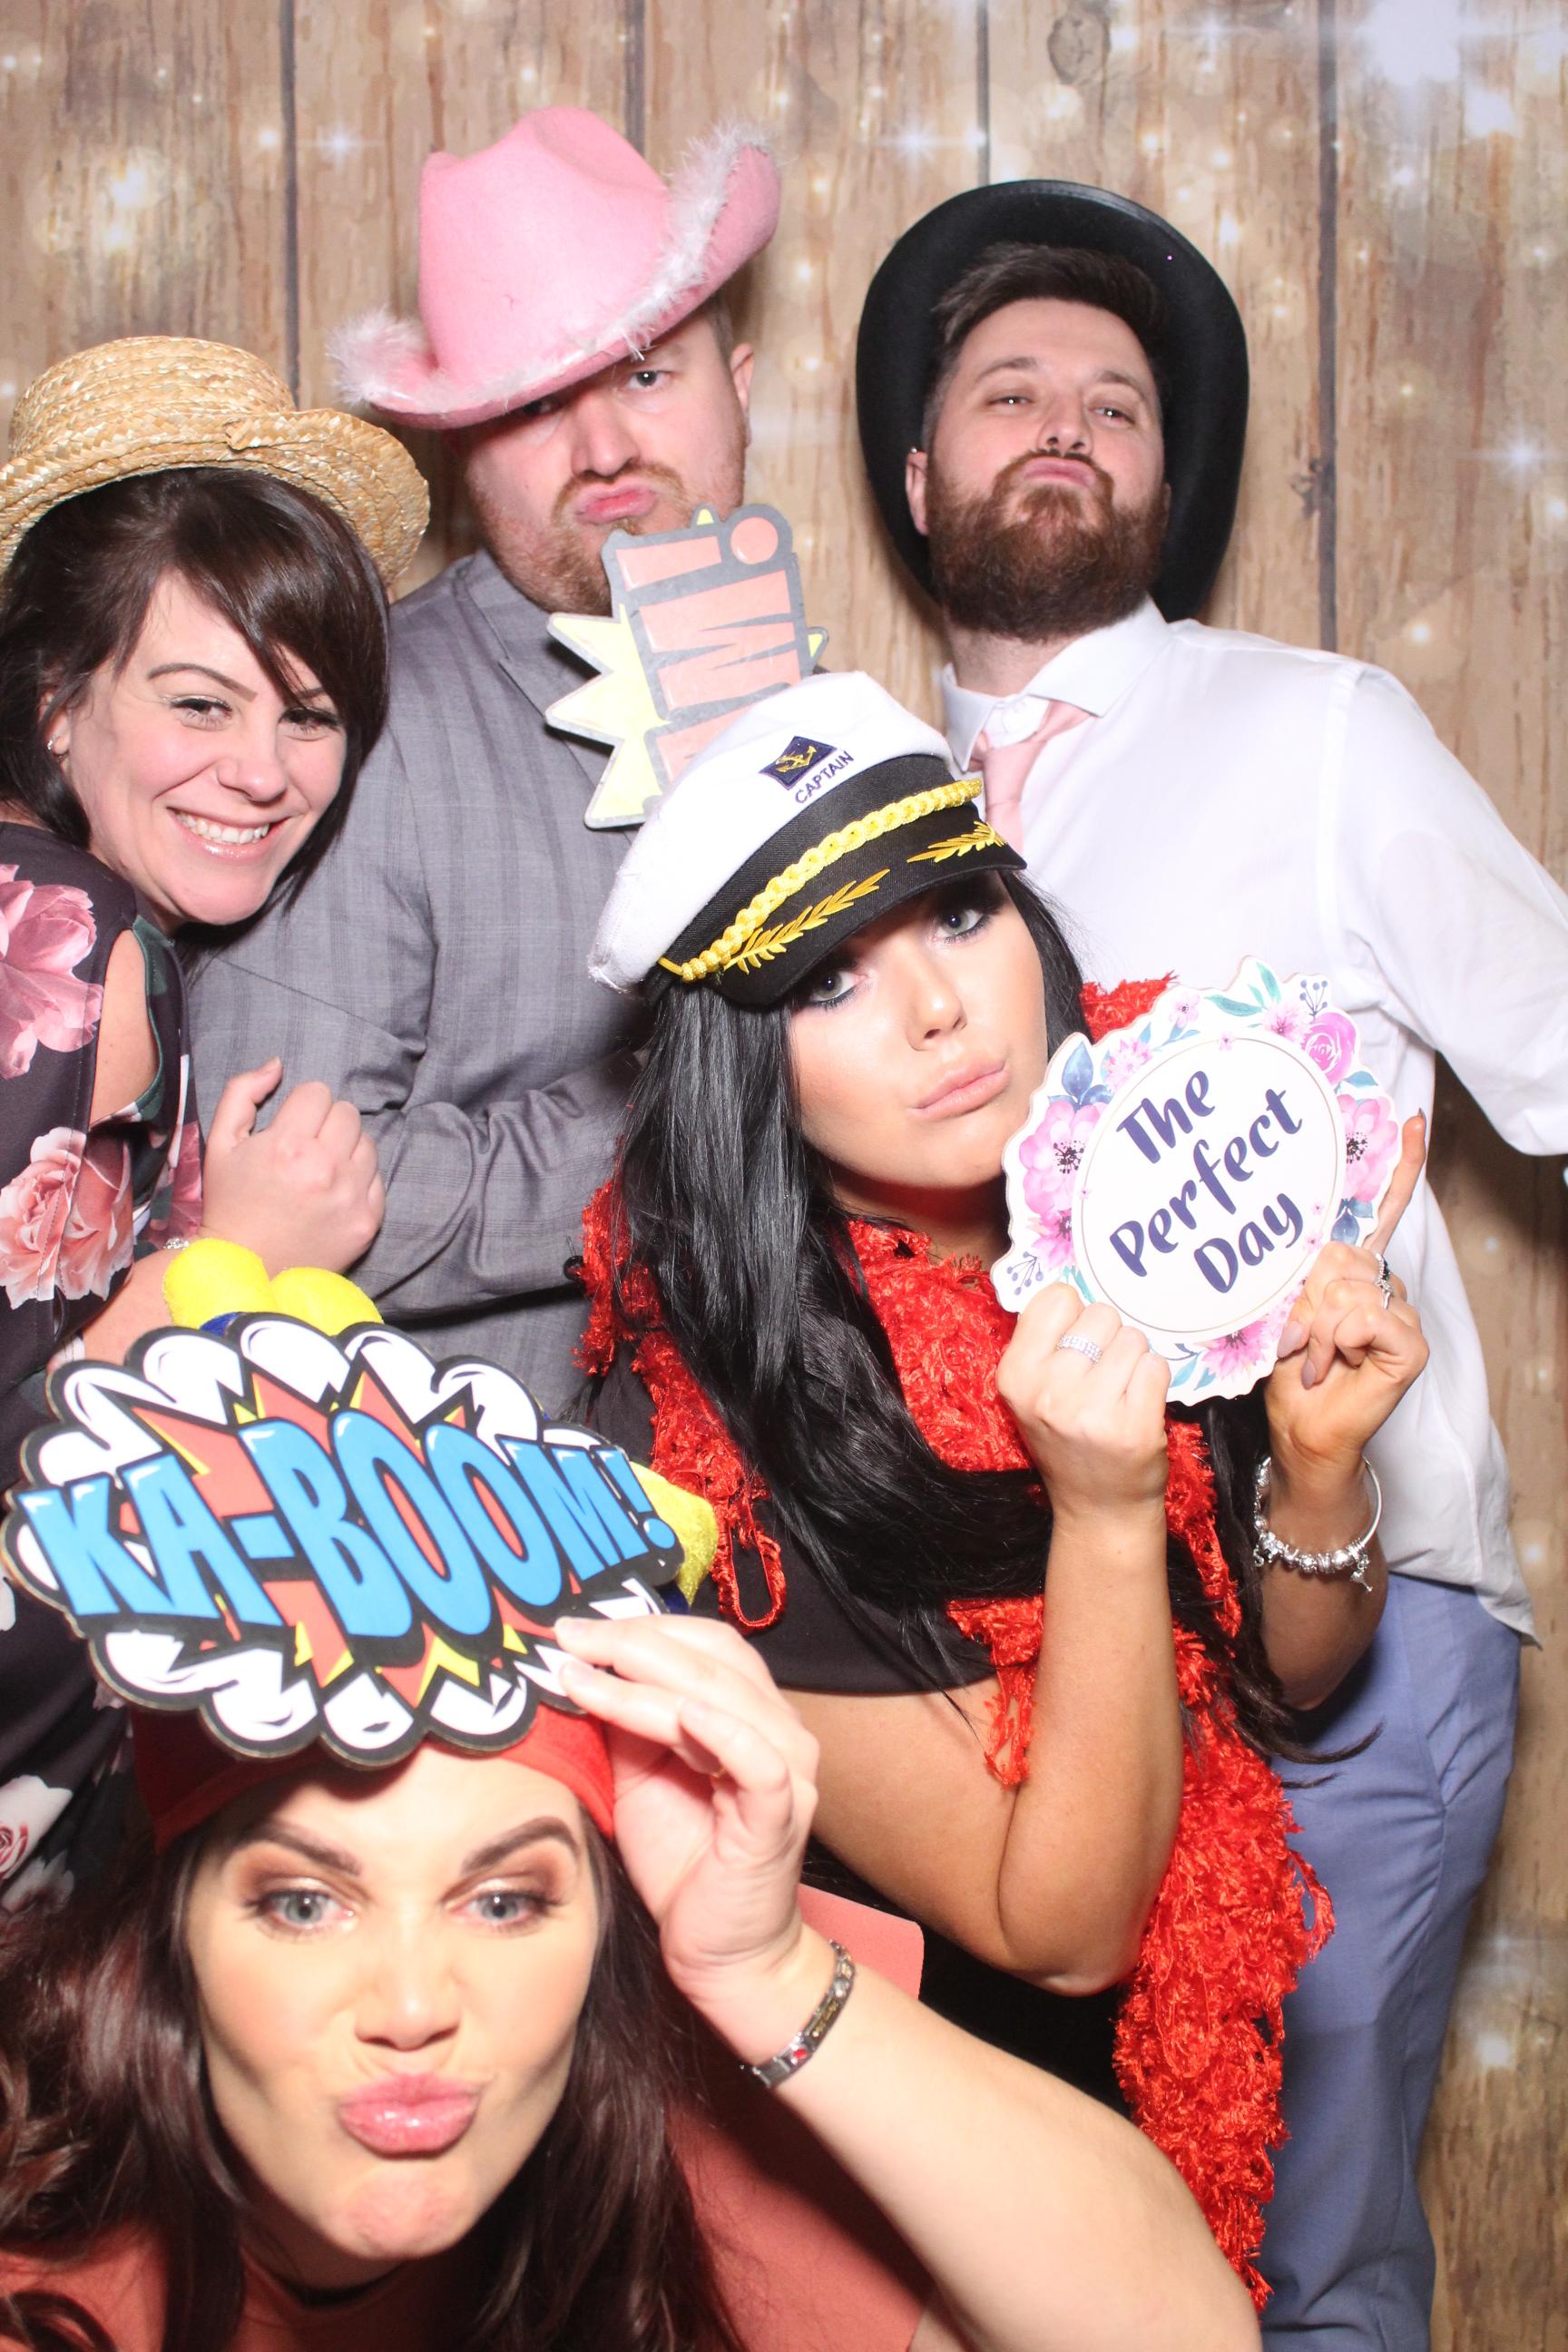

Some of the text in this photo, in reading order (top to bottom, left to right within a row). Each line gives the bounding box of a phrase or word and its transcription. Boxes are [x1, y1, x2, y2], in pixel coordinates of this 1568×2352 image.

[794, 750, 855, 804] CAPTAIN
[1116, 1071, 1215, 1164] The
[1110, 1088, 1303, 1277] Perfect
[1194, 1192, 1304, 1294] Day
[18, 1409, 677, 1638] KA-BOOM!
